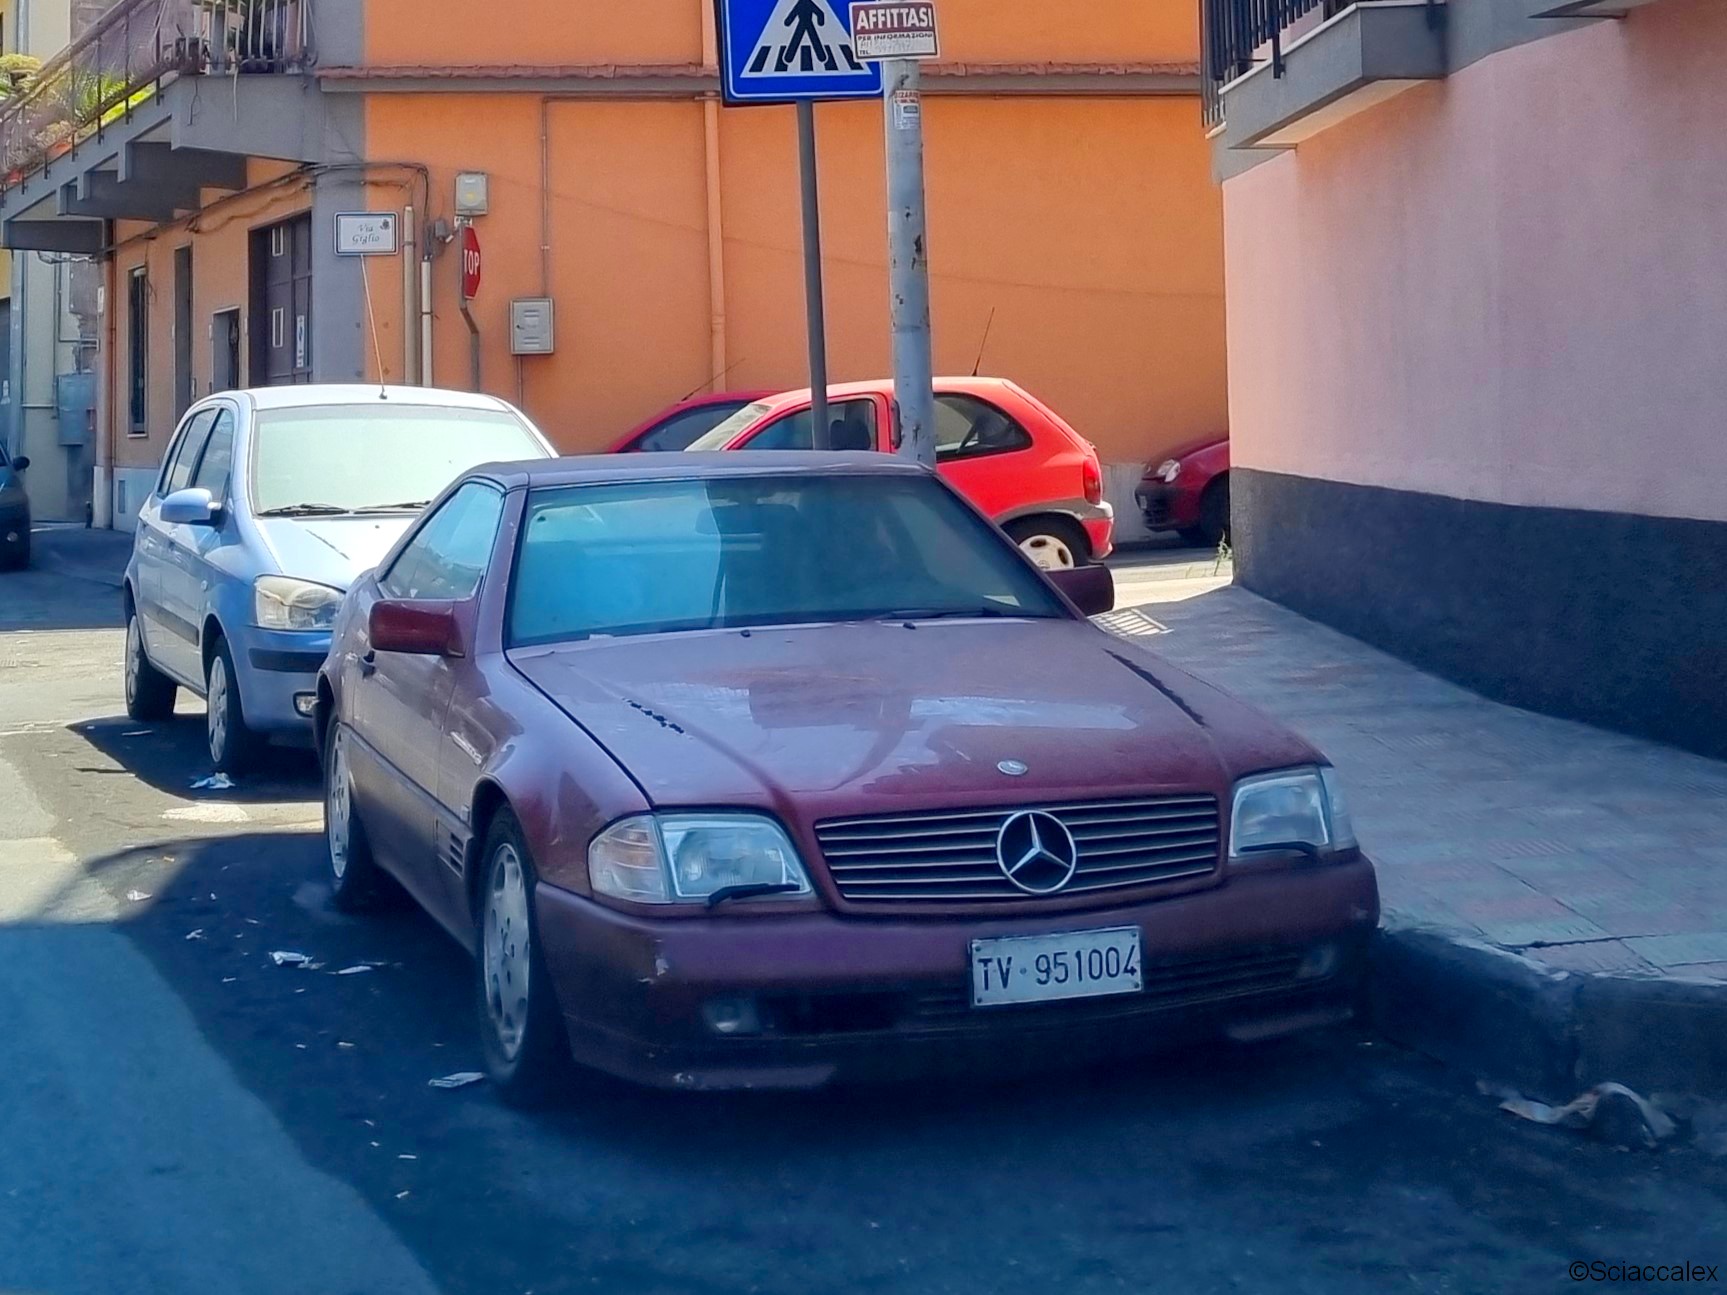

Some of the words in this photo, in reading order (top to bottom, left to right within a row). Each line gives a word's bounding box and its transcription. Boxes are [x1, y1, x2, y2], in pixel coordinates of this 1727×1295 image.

[856, 7, 933, 30] AFFITTASI
[874, 32, 933, 41] INFORMAZIONI
[358, 223, 373, 232] Via
[463, 249, 480, 275] TOP
[977, 956, 1012, 991] TV
[1035, 945, 1137, 985] 951004
